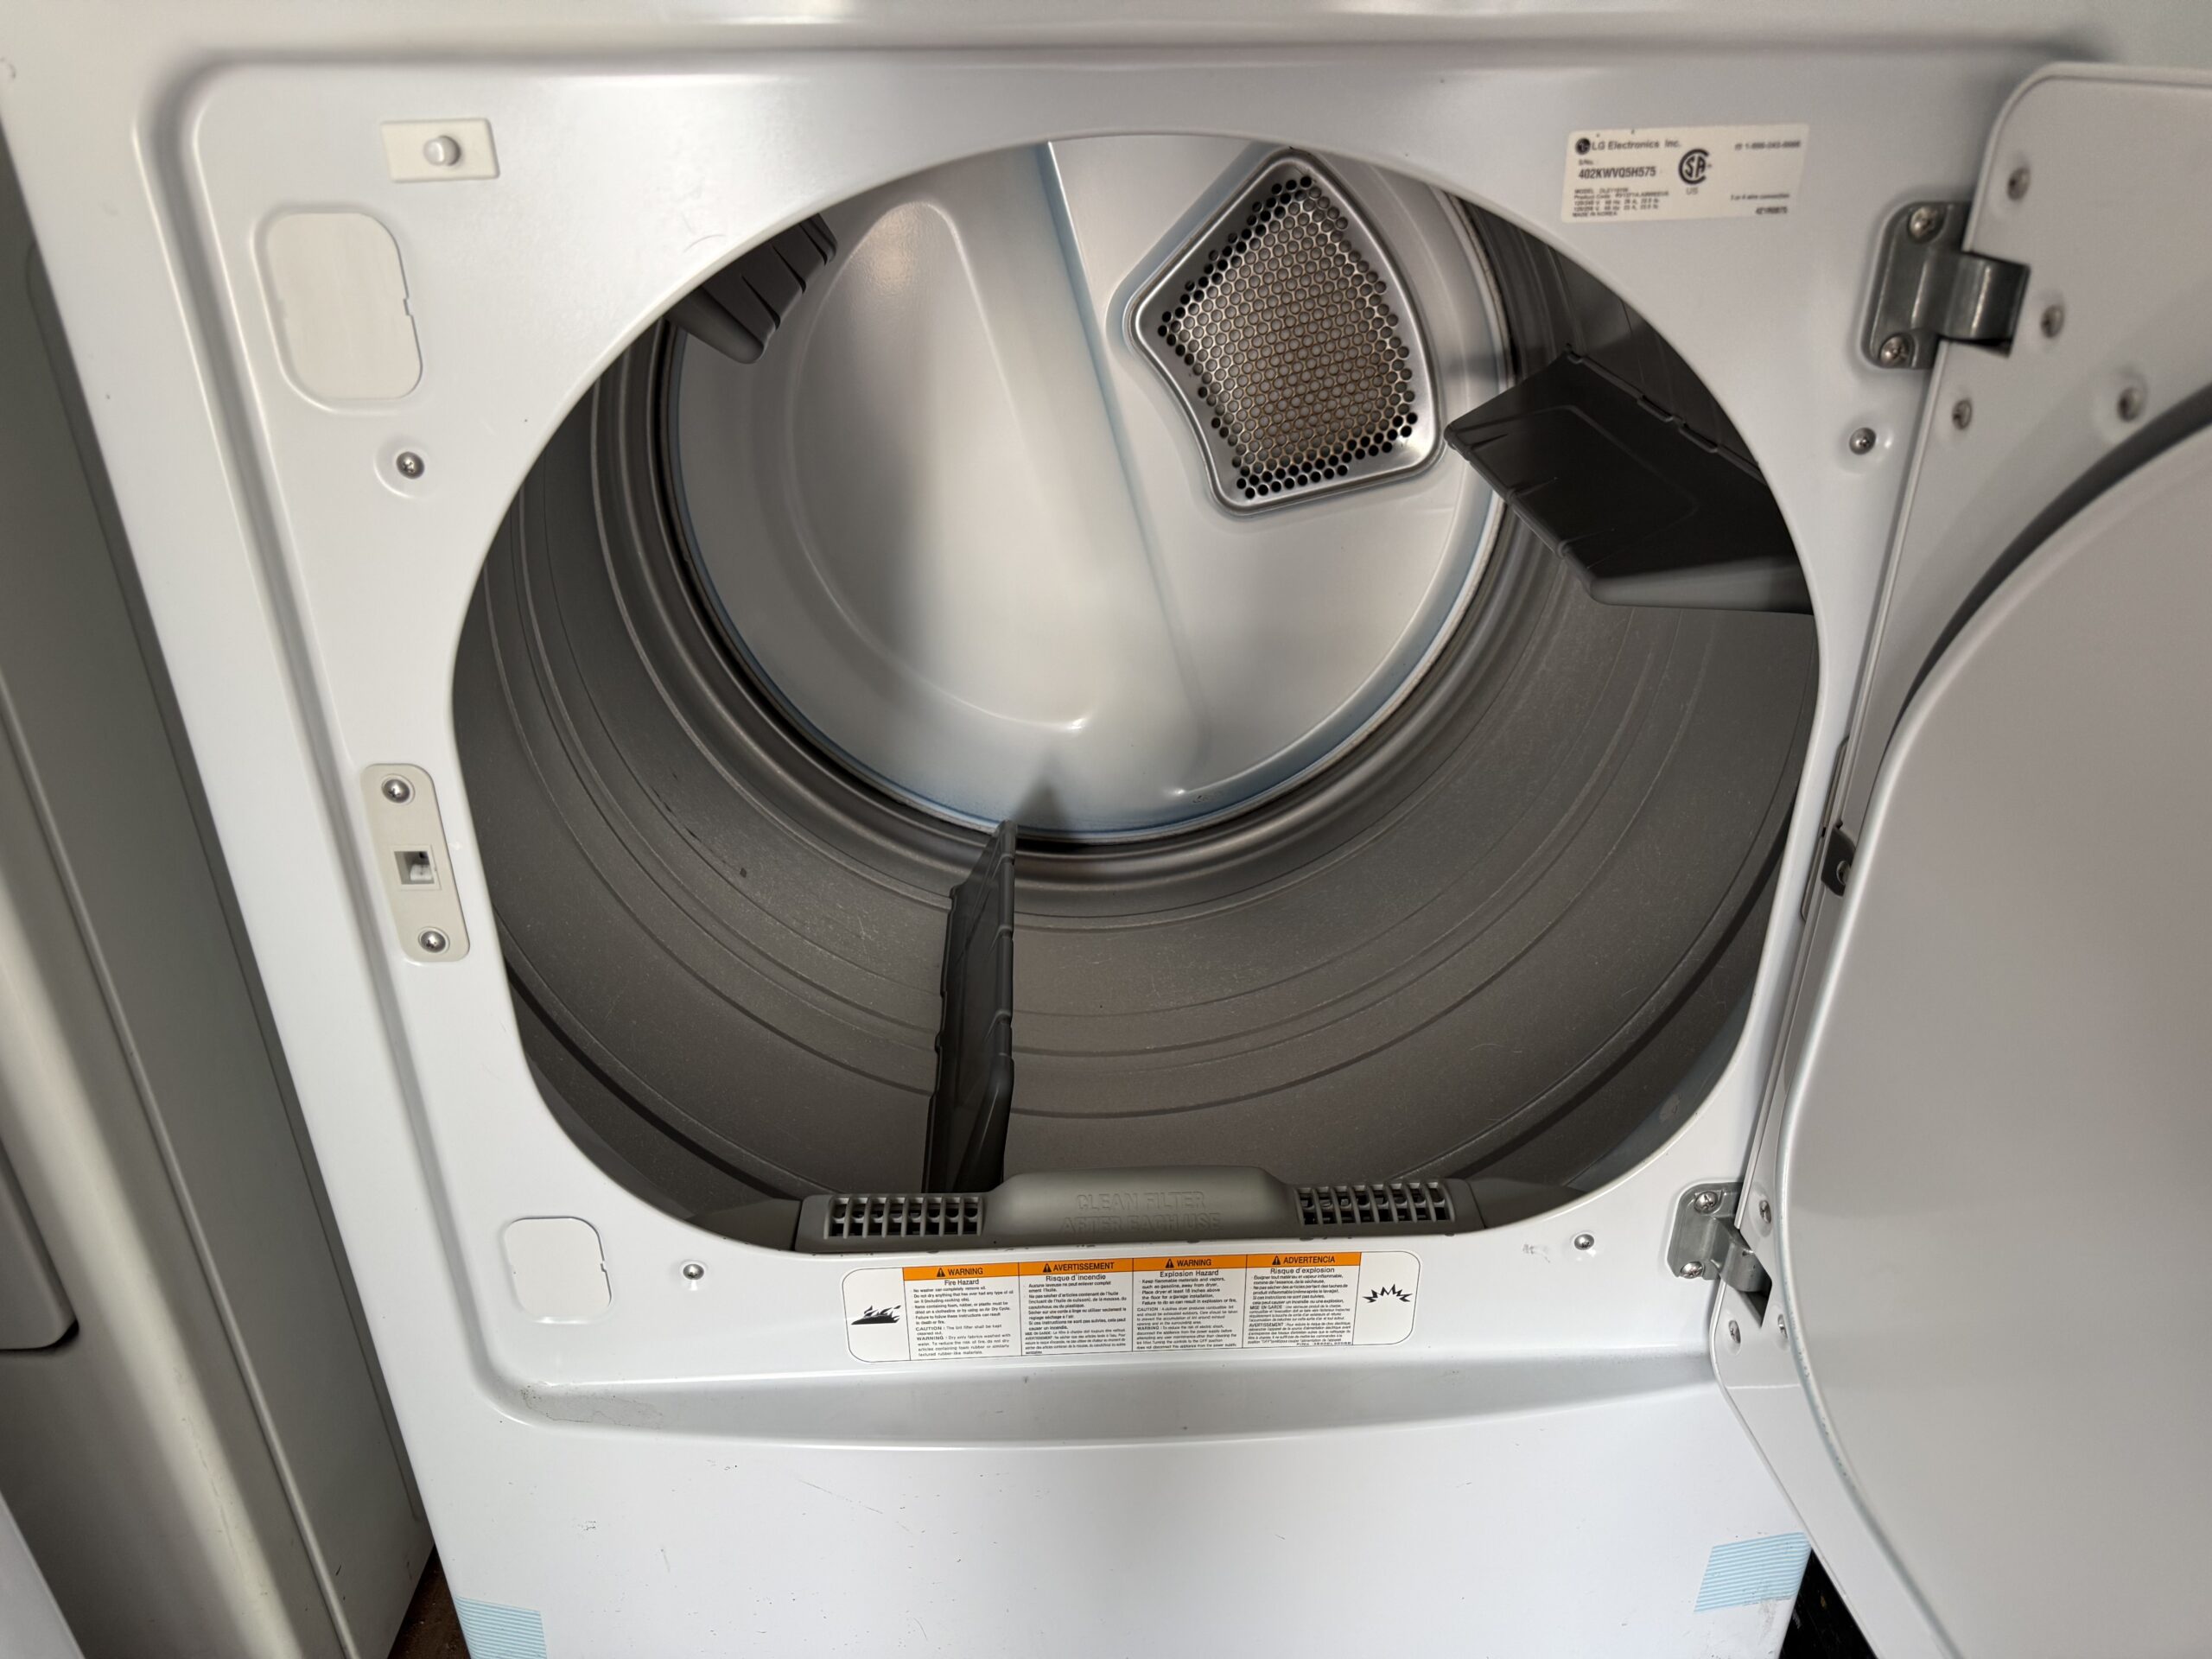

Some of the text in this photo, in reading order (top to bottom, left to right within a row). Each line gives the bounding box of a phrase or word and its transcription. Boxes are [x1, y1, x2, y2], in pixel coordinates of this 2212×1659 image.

[1592, 139, 1681, 150] LG Electronics Inc.
[1077, 1191, 1206, 1211] CLEAN FILTER
[1062, 1213, 1222, 1233] AFTER EACH USE
[948, 1267, 983, 1276] WARNING
[1053, 1262, 1114, 1271] AVERTISSEMENT
